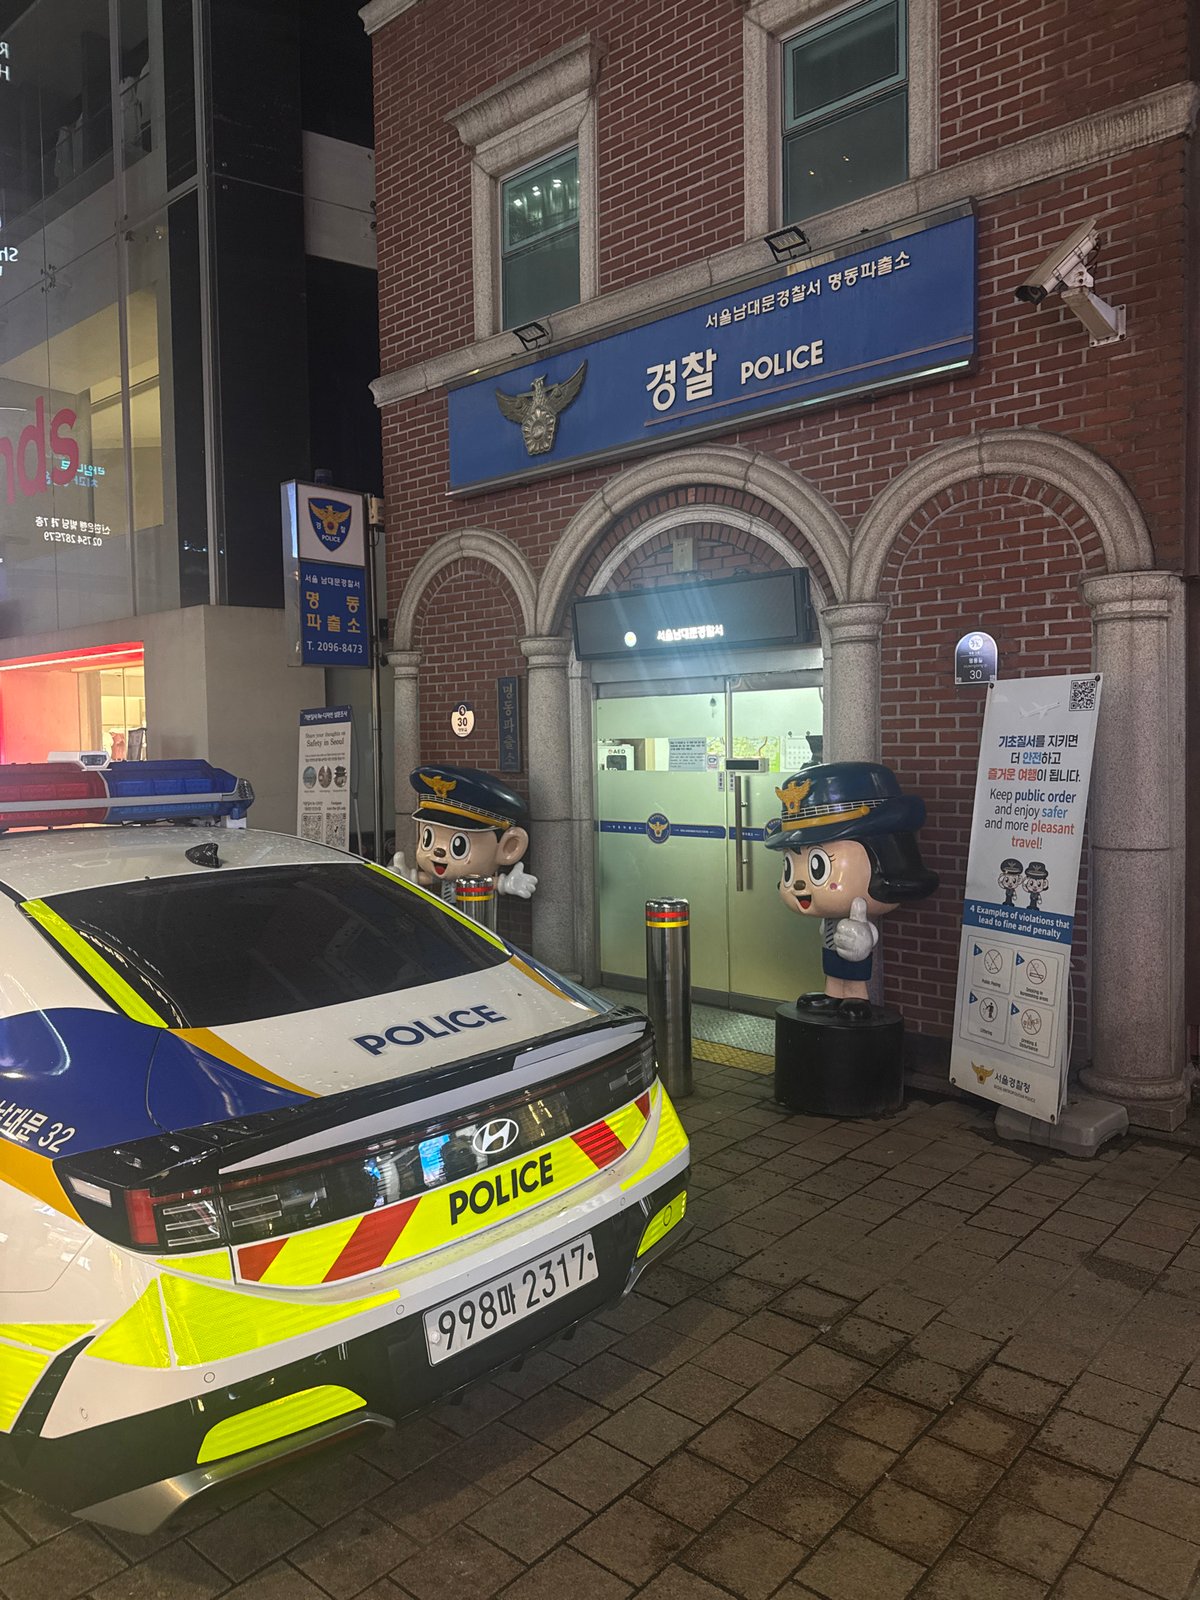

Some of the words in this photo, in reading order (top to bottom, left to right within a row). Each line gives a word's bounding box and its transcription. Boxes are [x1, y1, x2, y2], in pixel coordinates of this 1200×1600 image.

[705, 279, 821, 329] 서울남대문경찰서
[828, 250, 911, 291] 명동파출소
[740, 339, 824, 385] POLICE
[646, 348, 717, 411] 경찰
[321, 535, 341, 543] POLICE
[304, 574, 319, 584] 서울
[320, 576, 361, 589] 남대문경찰서
[305, 591, 360, 614] 명동
[306, 613, 361, 633] 파출소
[306, 641, 315, 651] T.
[317, 641, 363, 654] 2096-8473
[969, 669, 982, 680] 30
[457, 717, 468, 727] 30
[502, 683, 517, 766] 명동파출소
[306, 740, 323, 748] Safety
[330, 737, 345, 746] Seoul
[998, 734, 1046, 748] 기초질서를
[1047, 734, 1079, 748] 지키면
[1010, 752, 1020, 765] 더
[1022, 752, 1061, 765] 안전하고
[988, 768, 1016, 781] 즐거운
[1018, 768, 1047, 782] 여행이
[1049, 769, 1081, 783] 됩니다.
[989, 788, 1013, 803] Keep
[1014, 789, 1046, 804] public
[1047, 790, 1077, 804] order
[994, 803, 1013, 816] and
[1014, 804, 1040, 820] enjoy
[1041, 805, 1069, 819] safer
[984, 817, 1003, 830] and
[1004, 820, 1029, 832] more
[1030, 820, 1075, 836] pleasant
[1011, 836, 1043, 850] travel!
[969, 904, 975, 913] 4
[976, 905, 1010, 919] Examples
[1010, 911, 1019, 919] of
[1019, 912, 1055, 928] violations
[1055, 919, 1070, 930] that
[978, 914, 994, 926] lead
[994, 918, 1003, 928] to
[1003, 919, 1018, 931] fine
[1018, 923, 1032, 934] and
[1032, 926, 1062, 941] penalty
[353, 1005, 507, 1056] POLICE
[995, 1073, 1031, 1094] 서울경찰청
[38, 1122, 76, 1153] 32
[449, 1152, 554, 1226] POLICE
[438, 1282, 517, 1351] 998마
[522, 1243, 586, 1309] 2317
